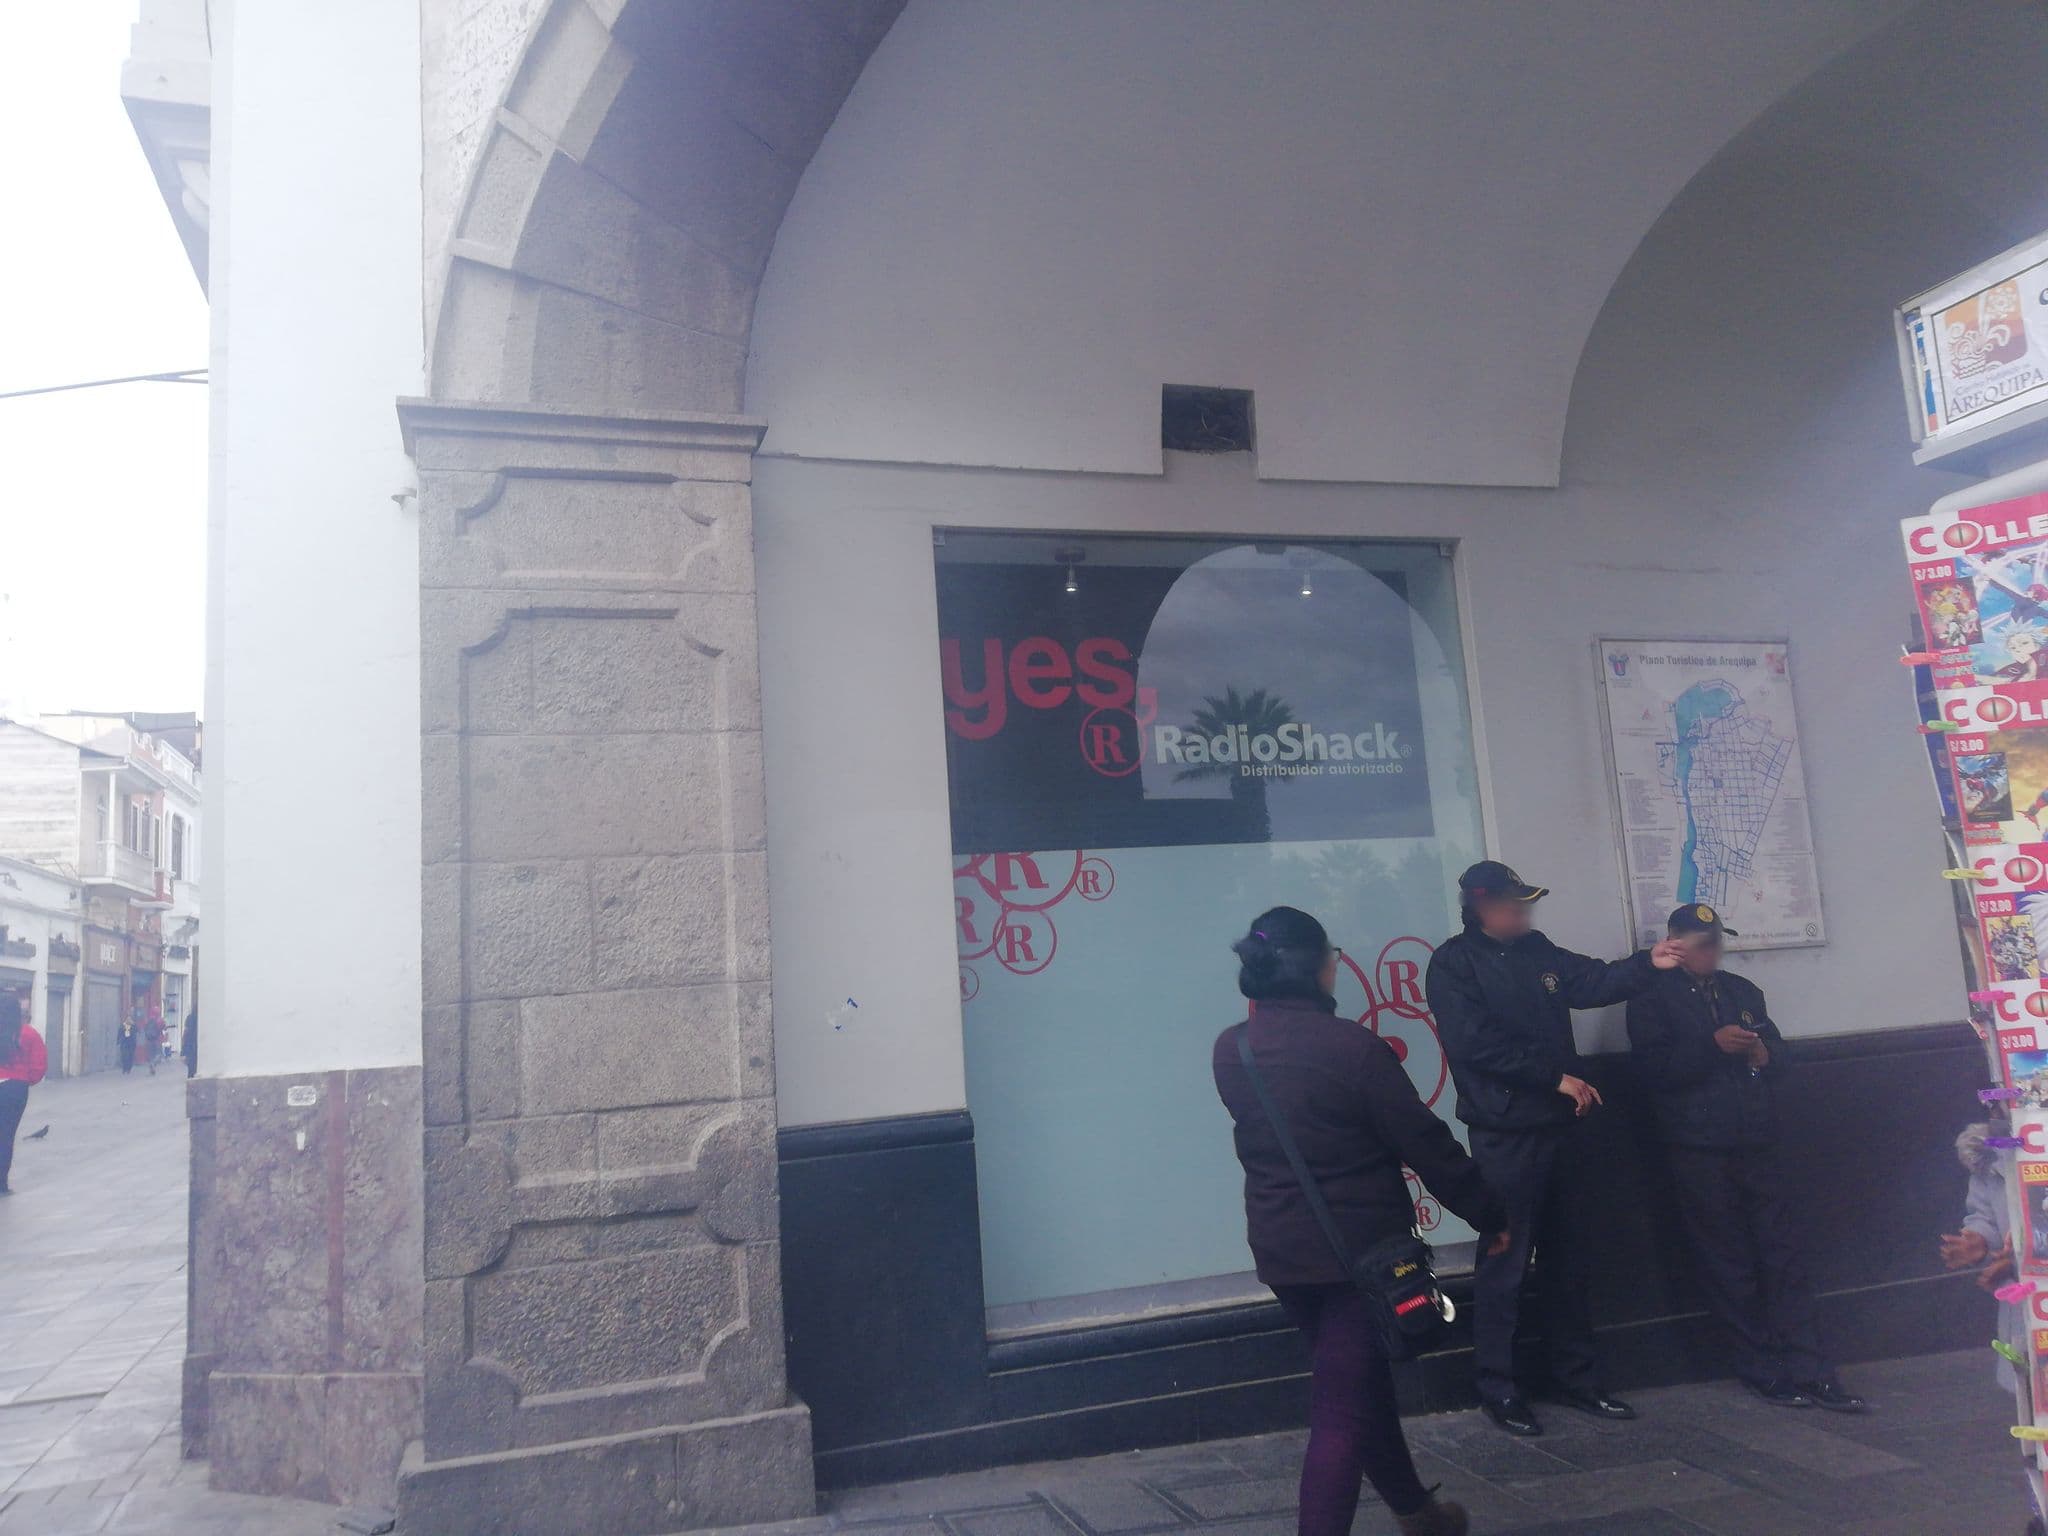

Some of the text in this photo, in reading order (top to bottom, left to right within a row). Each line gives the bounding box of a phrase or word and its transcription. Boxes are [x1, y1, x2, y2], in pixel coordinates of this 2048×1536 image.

[1950, 367, 2044, 416] AREQUIPA
[941, 635, 1159, 741] yes,
[1944, 695, 2048, 728] COL
[1240, 762, 1404, 778] Distribuidor autorizado
